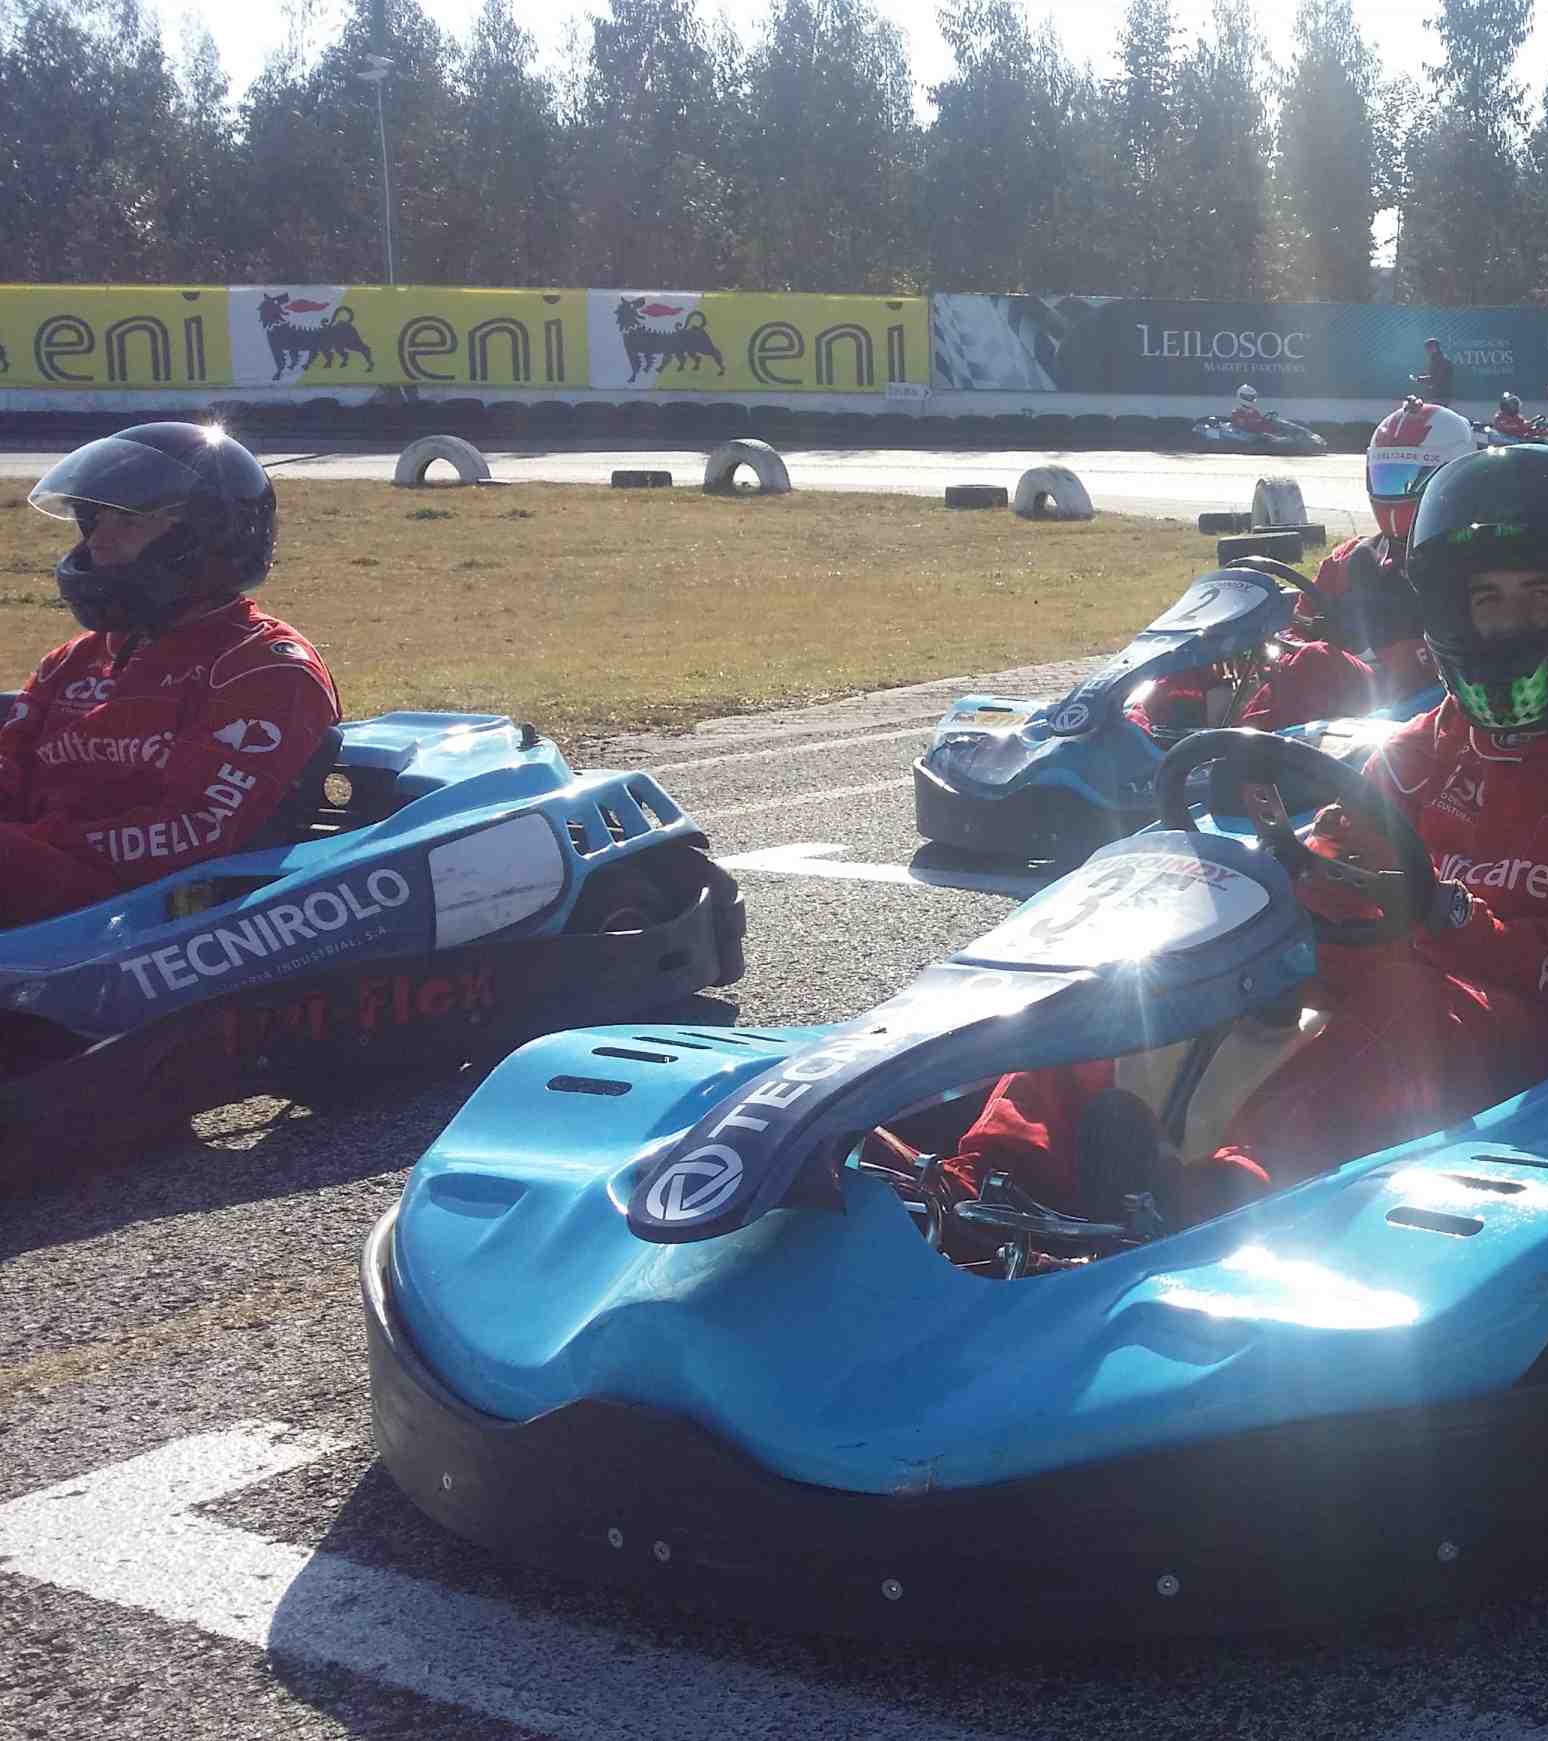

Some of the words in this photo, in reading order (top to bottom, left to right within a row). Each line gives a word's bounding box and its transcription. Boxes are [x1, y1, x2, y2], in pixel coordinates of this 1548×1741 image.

[34, 292, 206, 381] eni
[399, 293, 564, 381] eni
[747, 301, 904, 387] eni
[1137, 323, 1305, 359] LEILOSOC
[1173, 587, 1220, 621] 2
[119, 868, 411, 1000] TECNIROLO
